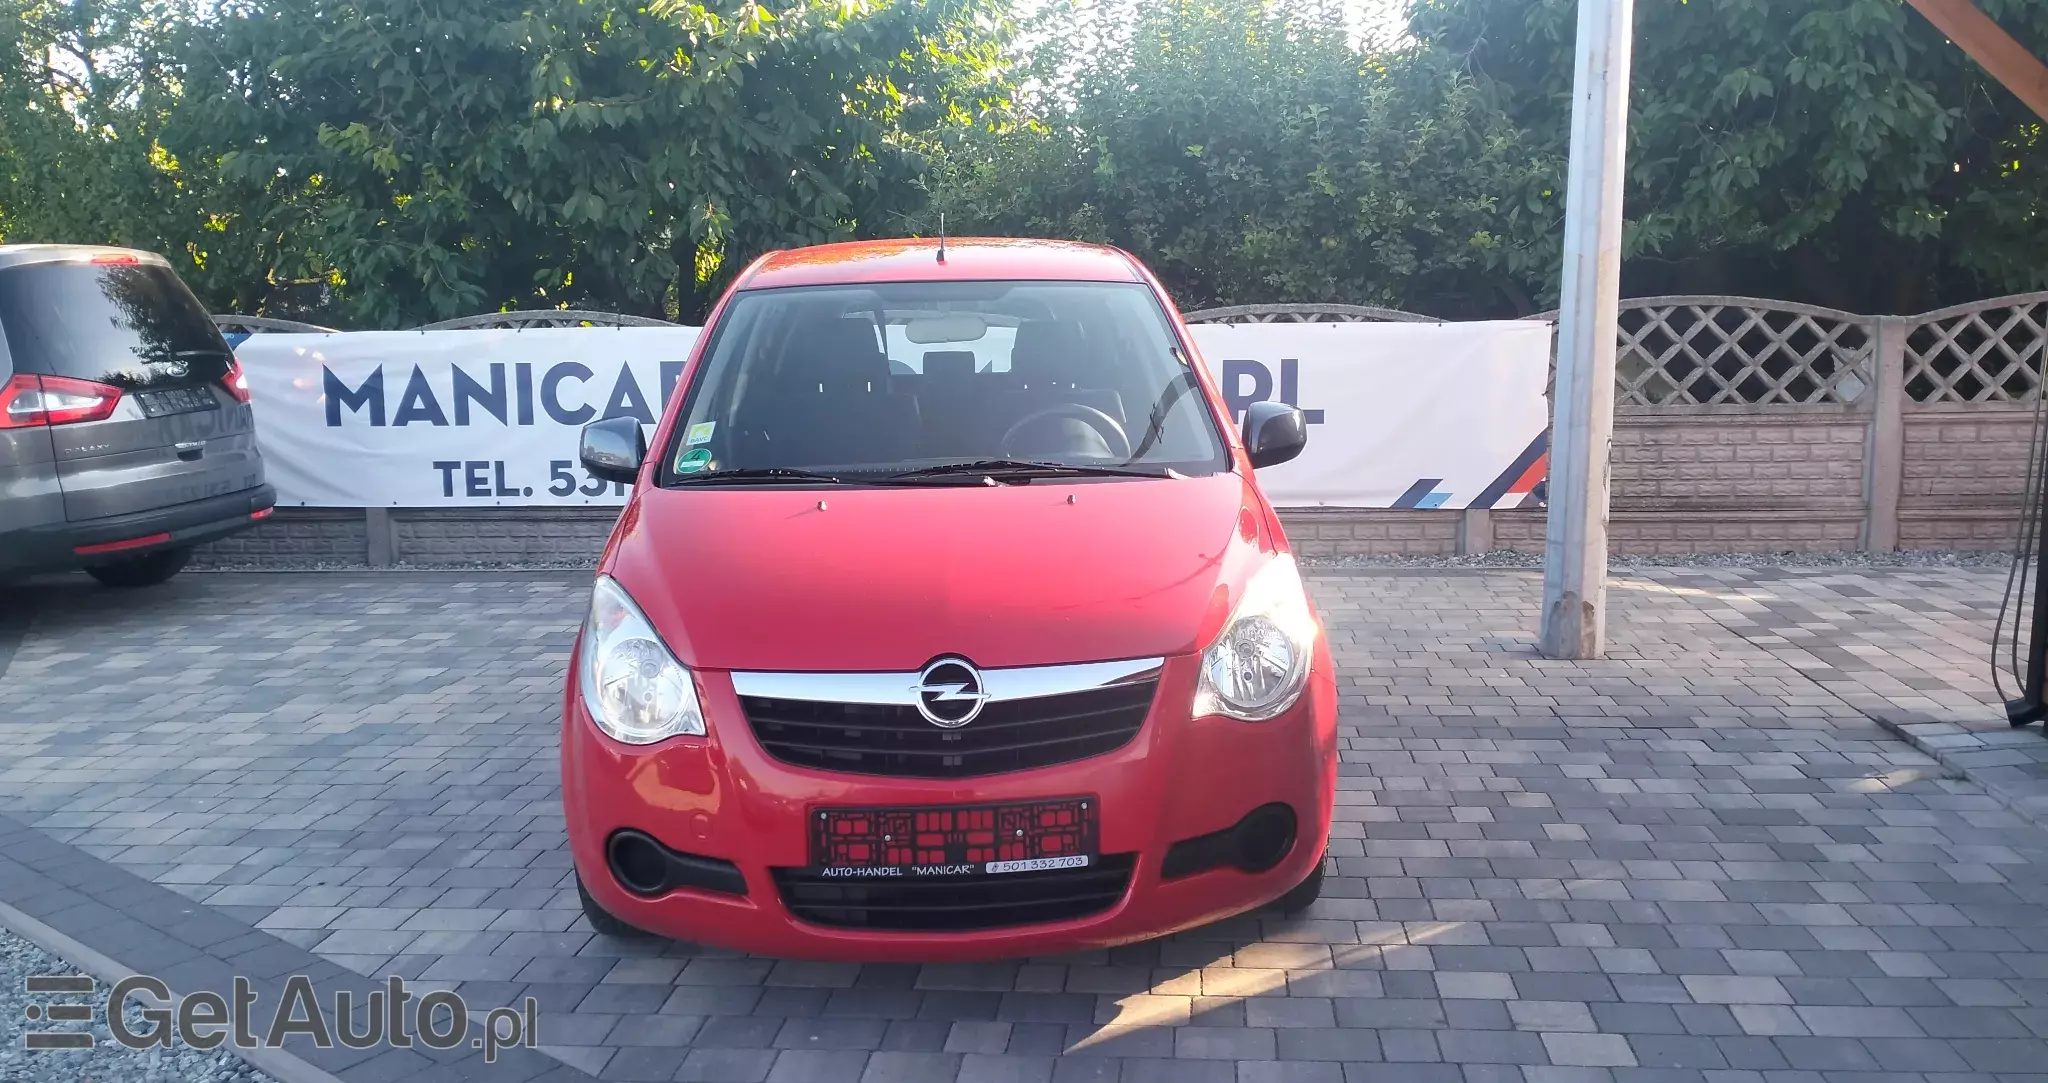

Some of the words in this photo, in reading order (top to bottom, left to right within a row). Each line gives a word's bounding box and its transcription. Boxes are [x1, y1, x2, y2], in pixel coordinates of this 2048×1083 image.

[690, 449, 702, 461] 4
[434, 461, 533, 497] TEL.
[822, 866, 903, 877] AUTO-HANDEL
[911, 864, 975, 876] "MANICAR"
[1003, 860, 1028, 872] 501
[1031, 858, 1056, 870] 332
[1059, 857, 1084, 868] 703
